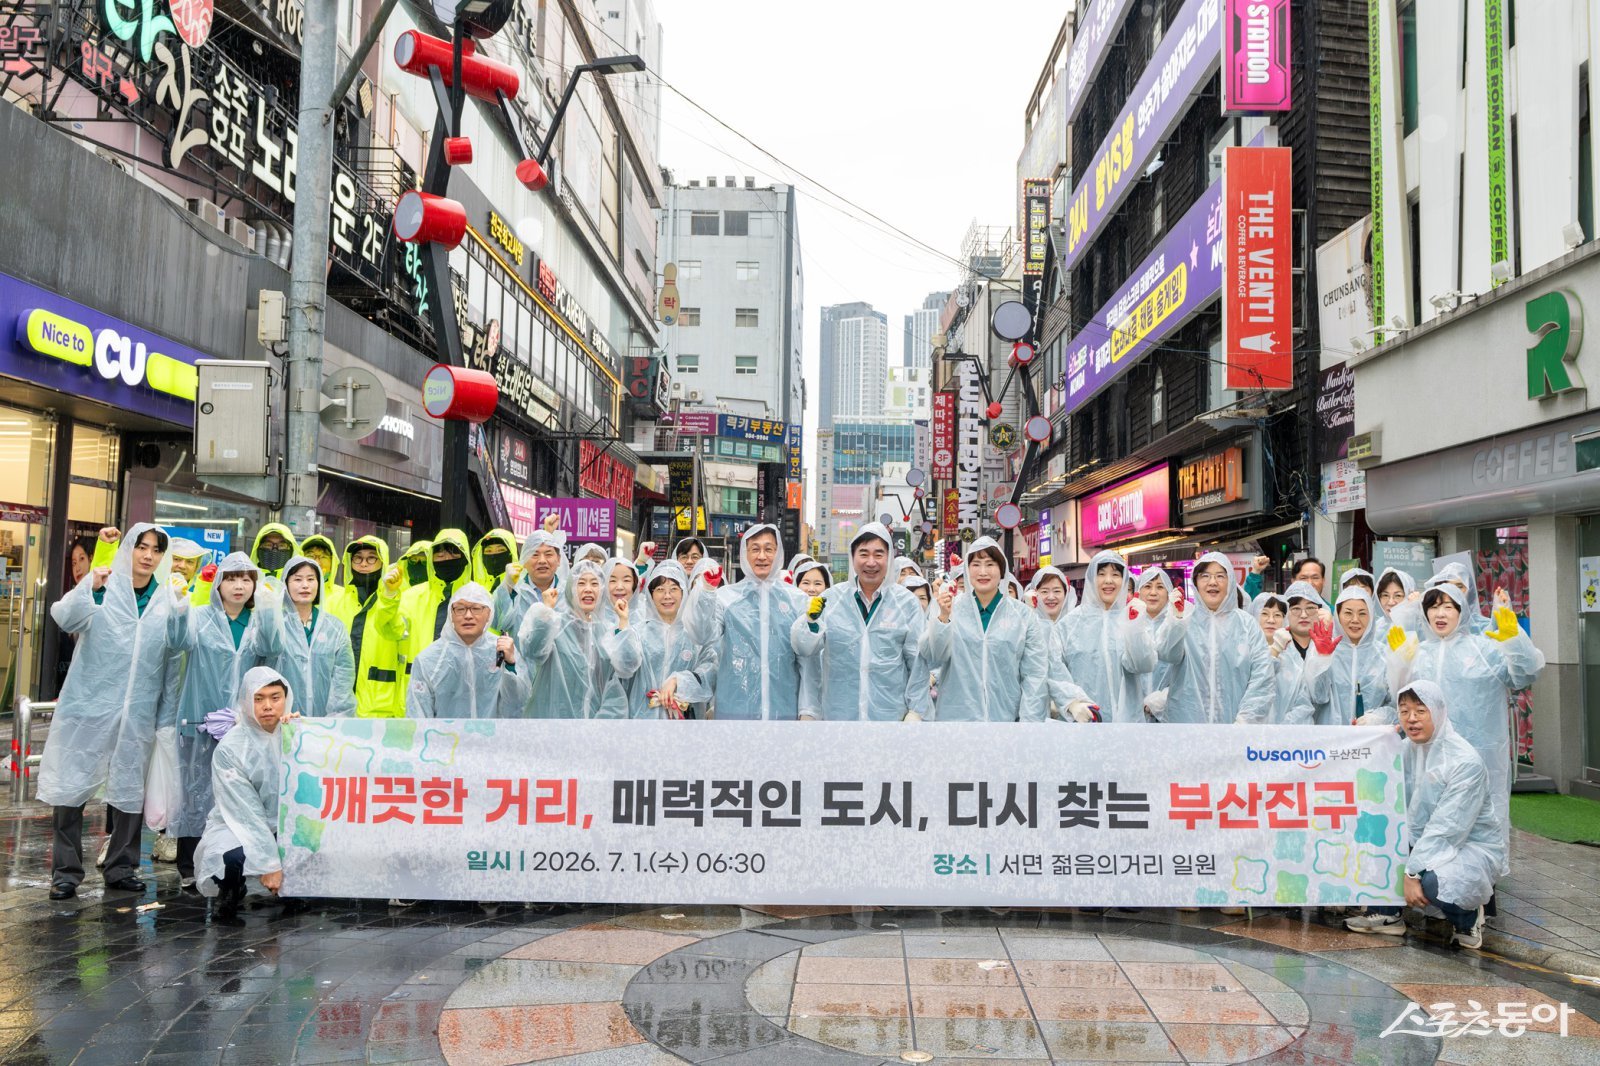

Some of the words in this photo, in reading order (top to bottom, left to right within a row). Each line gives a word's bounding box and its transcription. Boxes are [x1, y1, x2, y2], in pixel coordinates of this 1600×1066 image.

[0, 26, 41, 50] 입구
[1247, 4, 1270, 84] STATION
[1370, 6, 1379, 77] ROMAN
[81, 40, 113, 89] 입구
[212, 63, 249, 128] 소주
[1490, 74, 1501, 152] ROMAN
[209, 105, 247, 170] 호프
[1373, 102, 1381, 168] COFFEE
[1249, 191, 1274, 239] THE
[1374, 170, 1382, 234] ROMAN
[1493, 183, 1504, 263] COFFEE
[361, 213, 385, 265] 2F
[1237, 215, 1246, 246] COFFEE
[1237, 255, 1246, 298] BEVERAGE
[1249, 248, 1274, 323] VENTI
[1323, 272, 1366, 308] CHUNSANG
[1375, 260, 1383, 324] COFFEE
[42, 321, 70, 347] Nice
[73, 332, 85, 352] to
[95, 328, 146, 386] CU
[631, 357, 650, 398] PC
[726, 416, 785, 436] 럭키부동산
[790, 426, 801, 478] 럭키부동산
[937, 454, 949, 462] 3F
[1472, 431, 1570, 487] COFFEE
[576, 507, 610, 537] 패션몰
[1246, 745, 1327, 769] busanjin
[1328, 748, 1372, 761] 부산진구
[321, 776, 468, 826] 깨끗한
[486, 778, 593, 830] 거리,
[612, 780, 801, 828] 매력적인
[821, 780, 928, 832] 도시,
[947, 782, 1039, 829] 다시
[1058, 781, 1151, 829] 찾는
[1168, 781, 1358, 831] 부산진구
[466, 850, 511, 872] 일시
[533, 852, 600, 873] 2026.
[608, 853, 625, 873] 7.
[633, 852, 689, 875] 1.(수)
[696, 853, 766, 874] 06:30
[933, 854, 978, 876] 장소
[999, 854, 1043, 876] 서면
[1052, 854, 1164, 876] 젊음의거리
[1172, 854, 1217, 876] 일원
